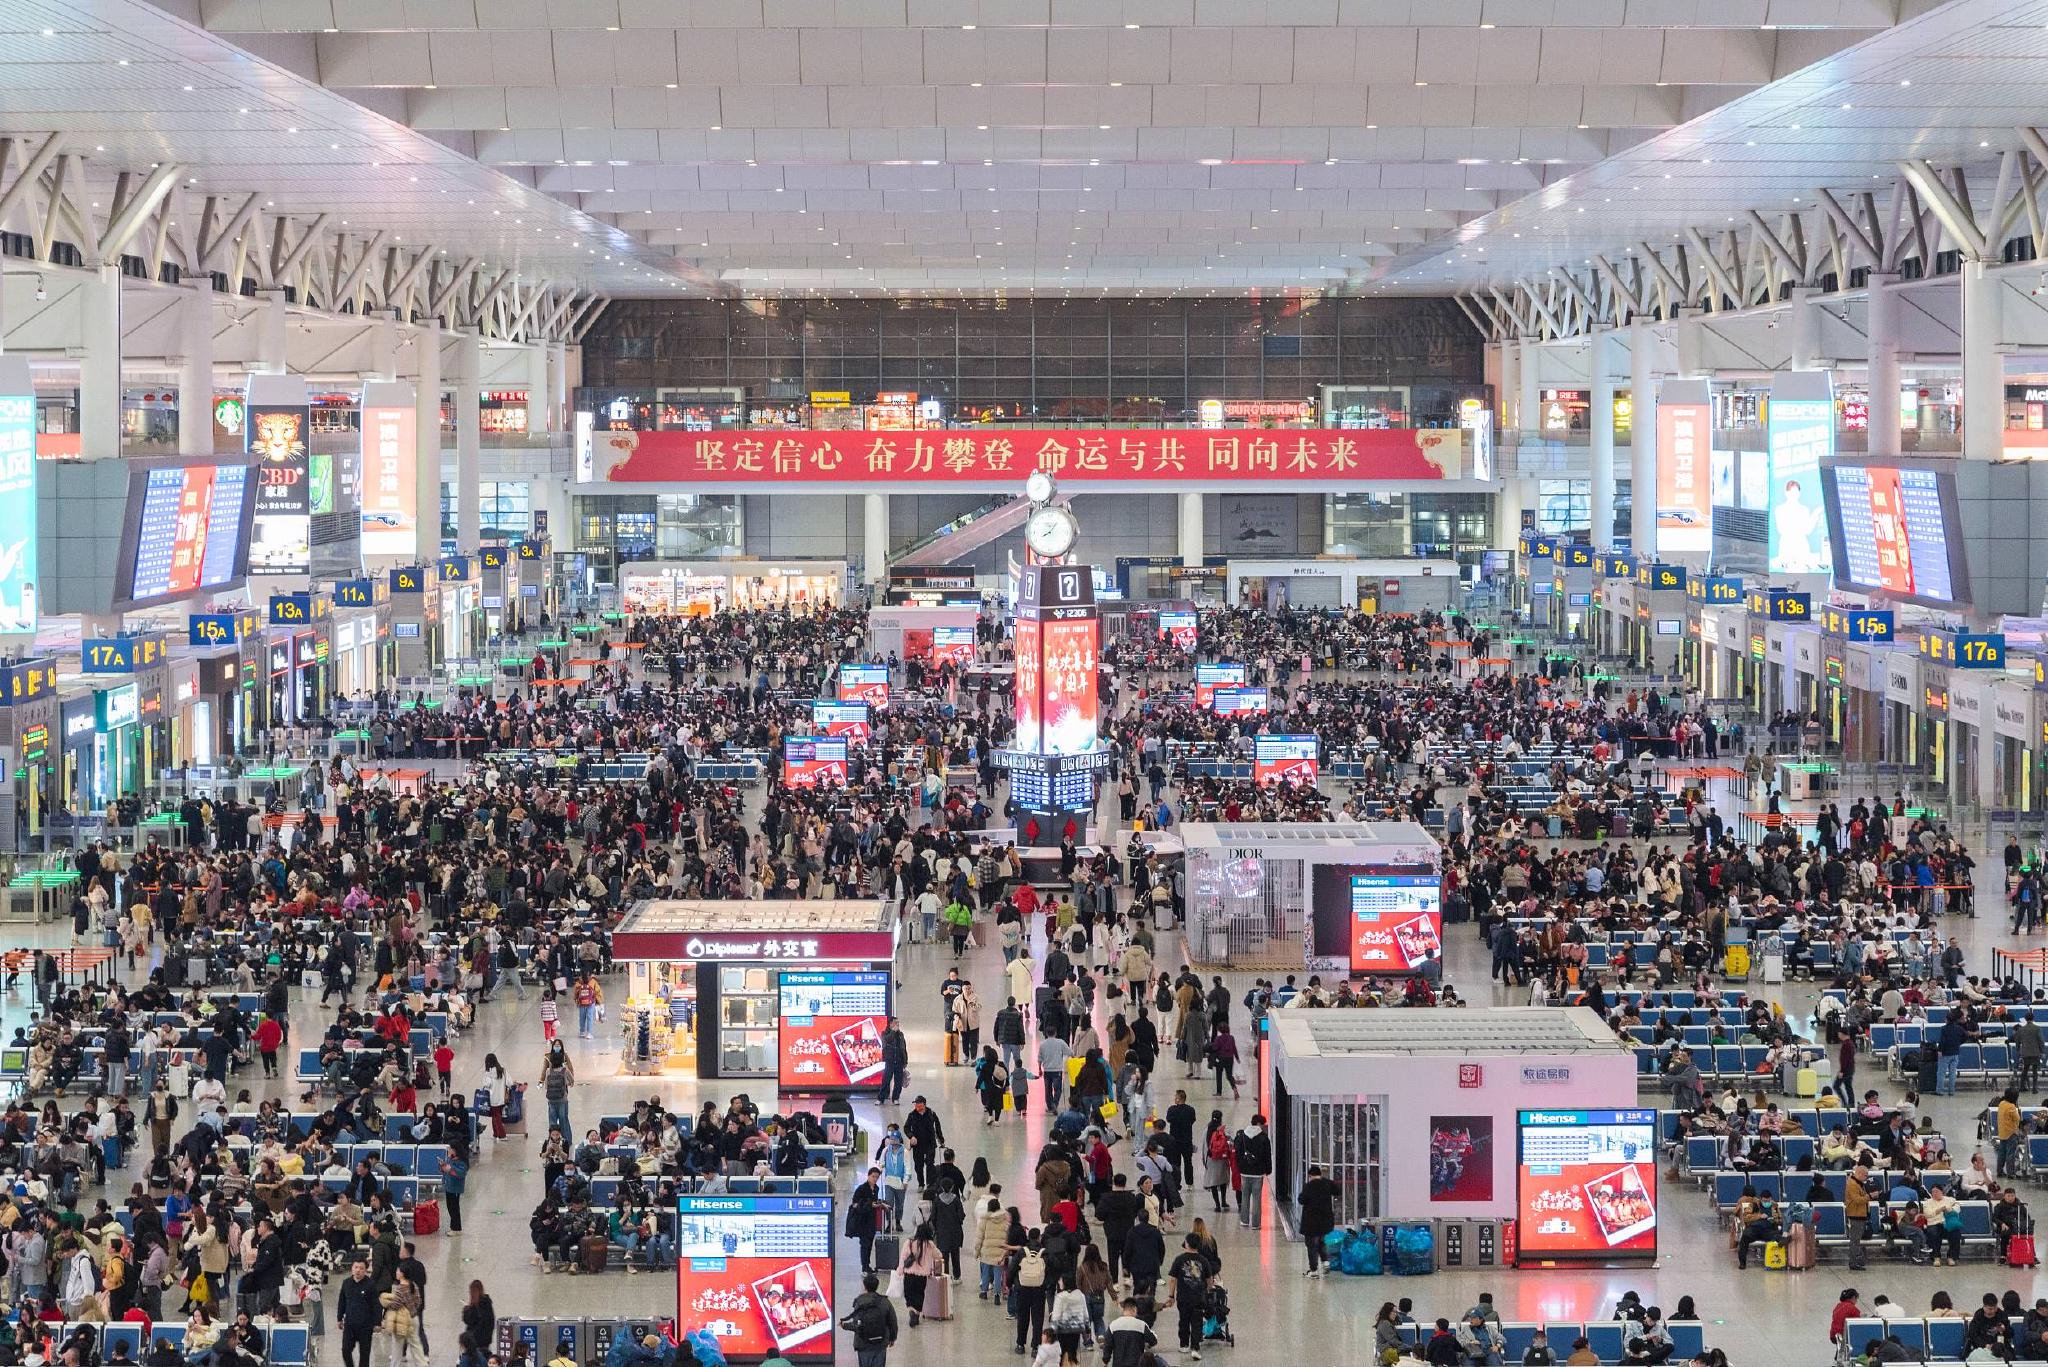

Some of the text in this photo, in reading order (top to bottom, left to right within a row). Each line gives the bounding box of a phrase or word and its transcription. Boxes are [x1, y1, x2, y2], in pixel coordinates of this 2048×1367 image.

[693, 436, 1360, 474] 坚定信心 奋力攀登 命运与共 同向未来
[259, 468, 299, 486] CBD
[522, 545, 534, 558] 3A
[1538, 543, 1550, 555] 3B
[485, 553, 500, 567] 5A
[1573, 550, 1588, 564] 5B
[444, 562, 460, 577] 7A
[1614, 560, 1630, 575] 7B
[398, 574, 415, 588] 9A
[1660, 571, 1678, 585] 9B
[341, 586, 366, 602] 11A
[1712, 584, 1737, 599] 11B
[276, 602, 303, 618] 13A
[1066, 608, 1087, 618] 12306
[1776, 599, 1806, 615] 13B
[196, 621, 227, 638] 15A
[1856, 617, 1888, 634] 15B
[89, 646, 125, 666] 17A
[1963, 641, 1998, 661] 17B
[1048, 648, 1094, 673] 欢欢喜喜
[1055, 672, 1089, 696] 中国年
[1228, 848, 1264, 860] DIOR
[1357, 878, 1390, 886] Hisense
[763, 940, 819, 958] 外交官
[787, 974, 826, 984] Hisense
[1522, 1066, 1570, 1081] 旅途易购
[1529, 1113, 1577, 1124] Hisense
[690, 1199, 743, 1210] Hisense
